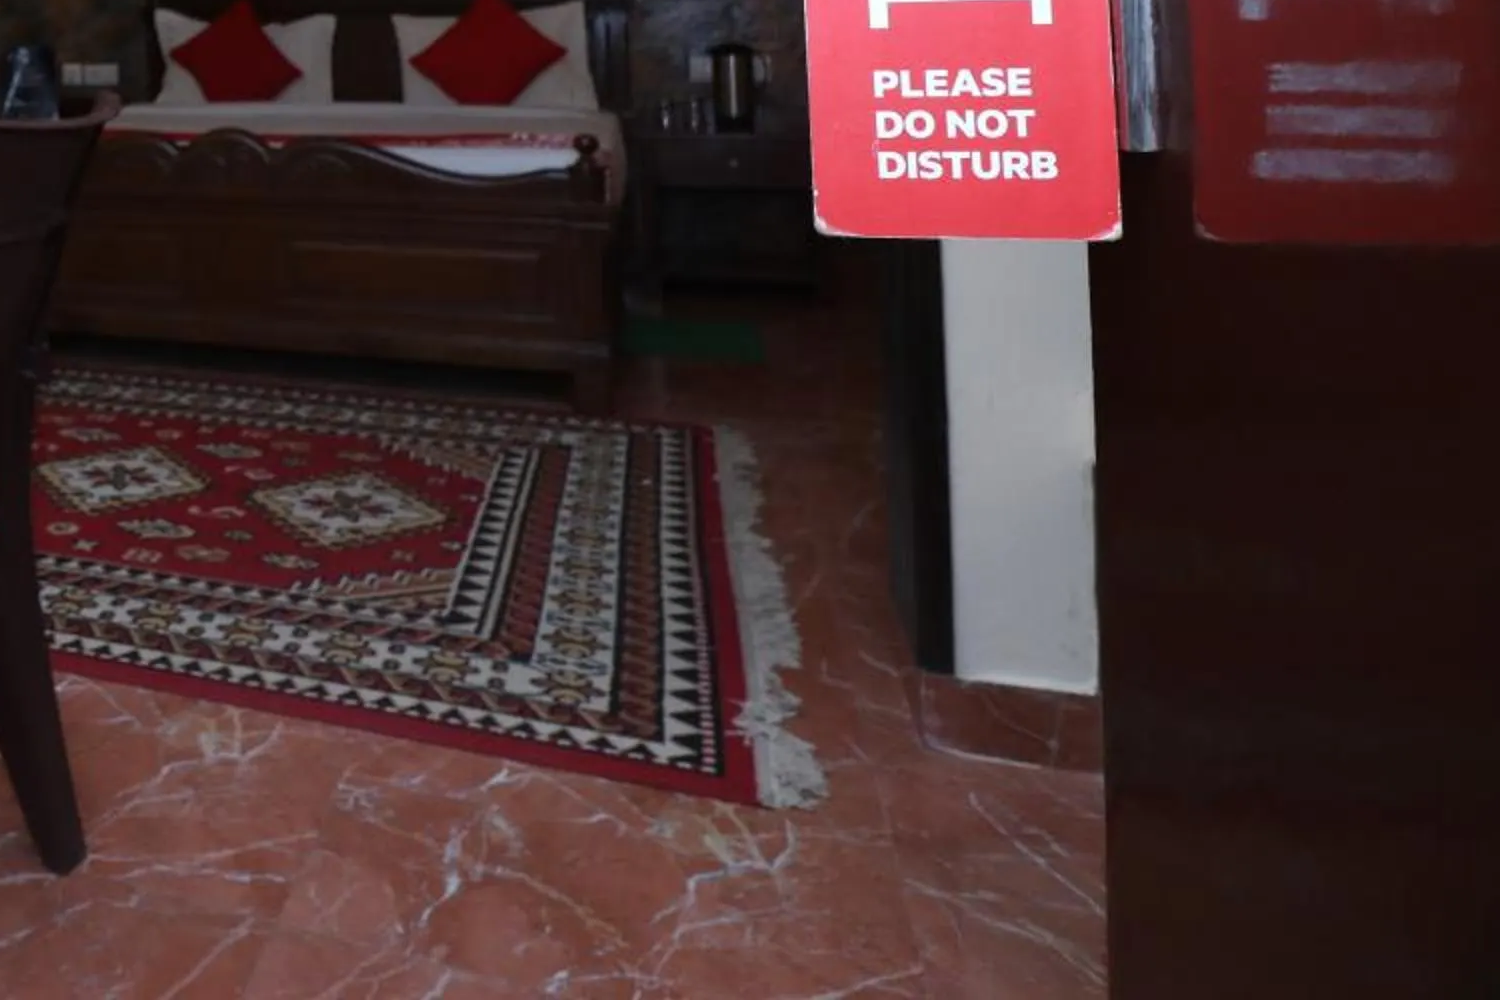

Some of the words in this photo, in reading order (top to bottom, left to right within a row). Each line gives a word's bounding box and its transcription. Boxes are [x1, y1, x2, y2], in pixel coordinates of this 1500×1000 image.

[873, 67, 1033, 98] PLEASE
[875, 109, 936, 139] DO
[945, 109, 1036, 139] NOT
[876, 150, 1059, 180] DISTURB
